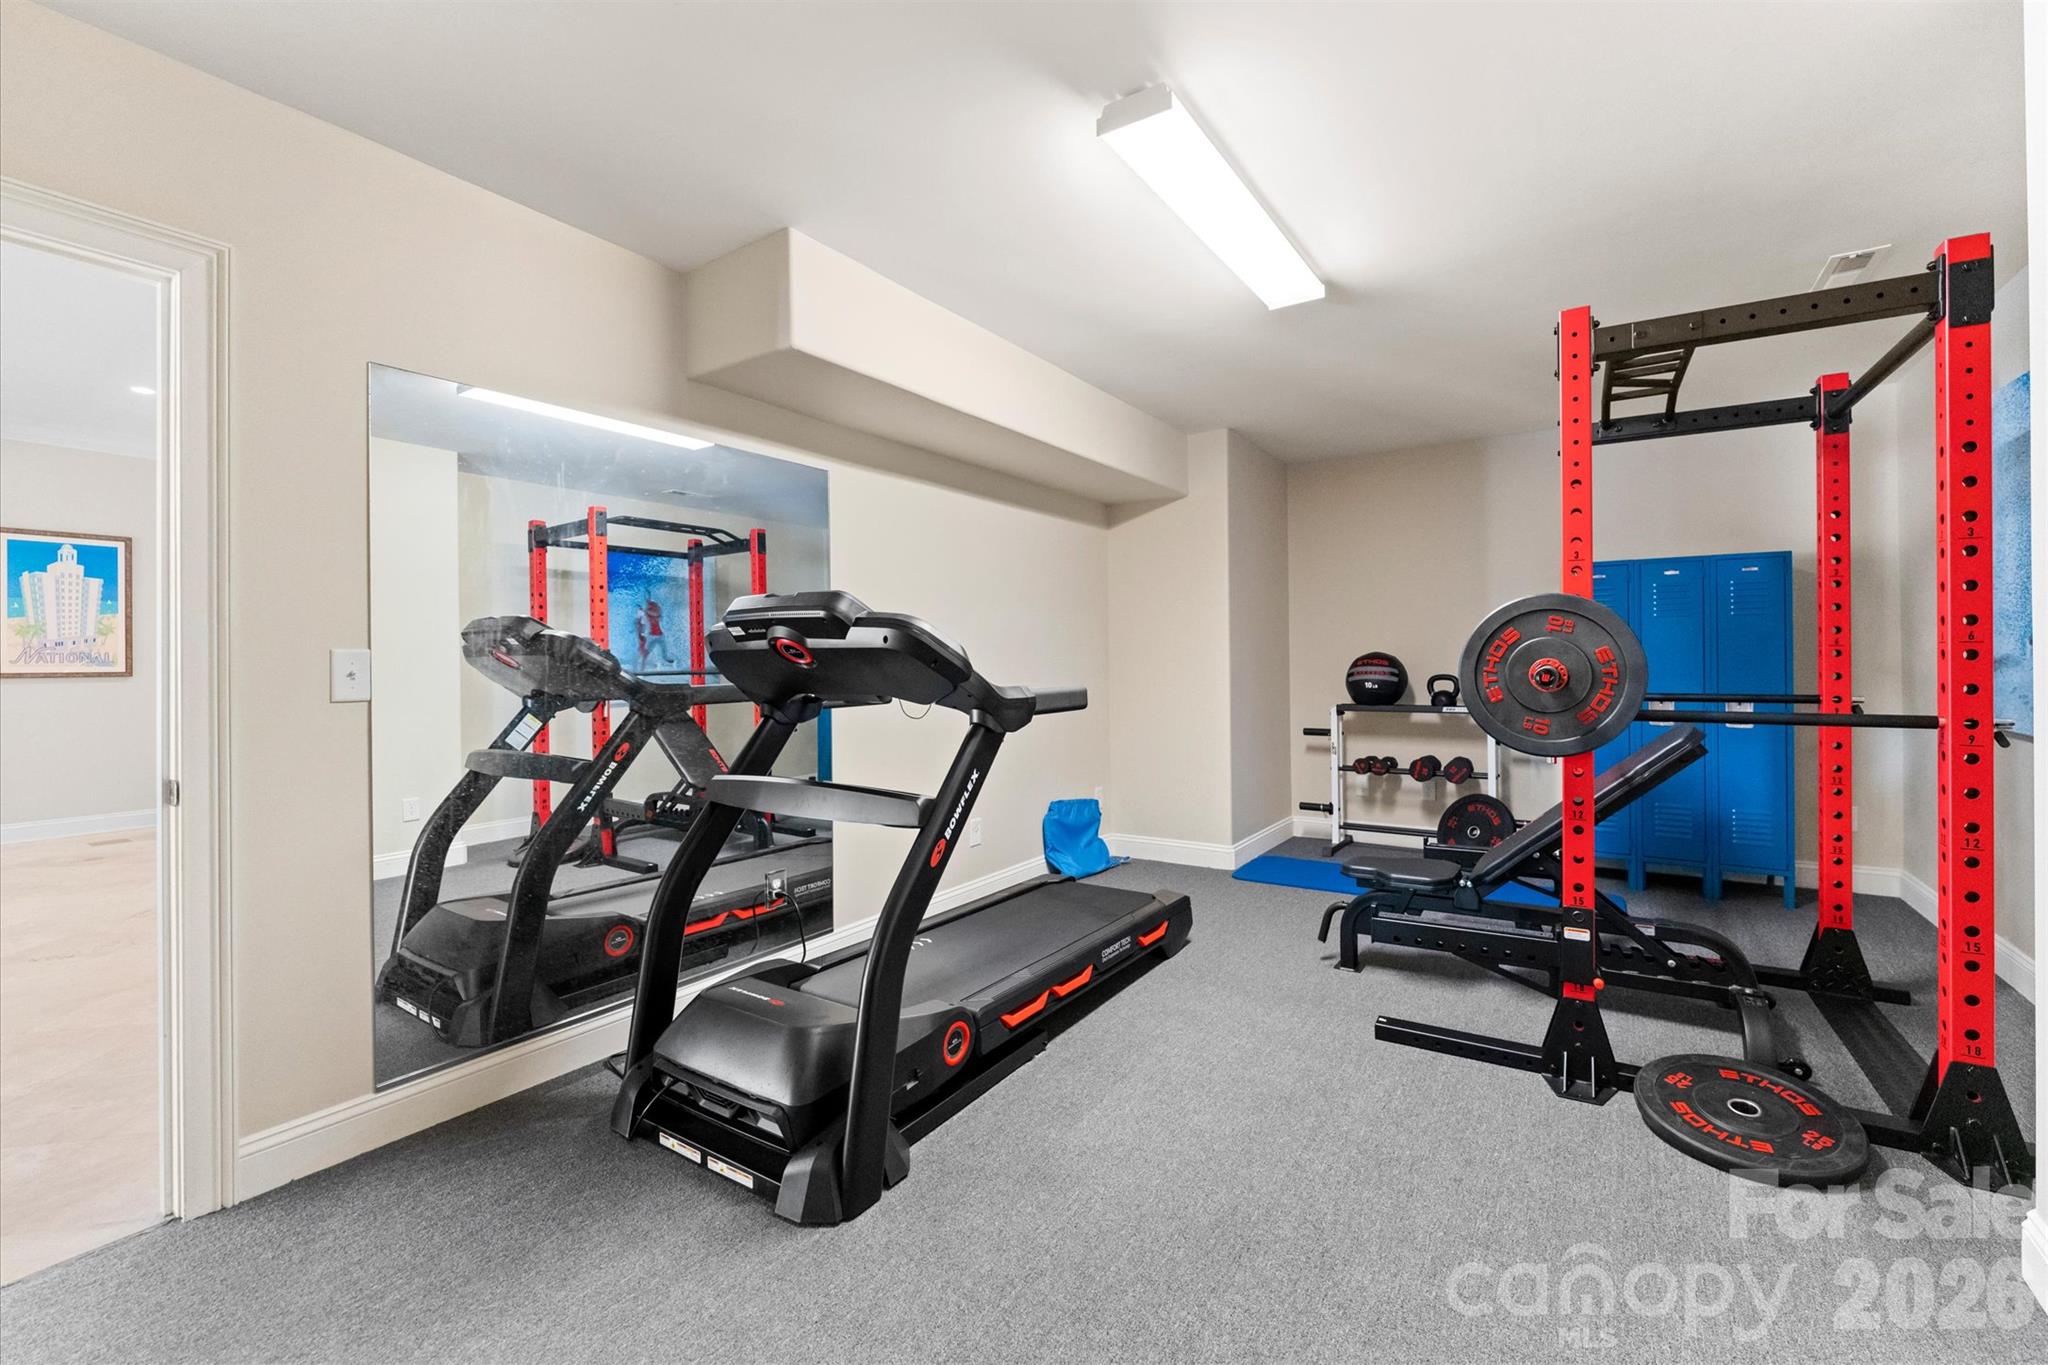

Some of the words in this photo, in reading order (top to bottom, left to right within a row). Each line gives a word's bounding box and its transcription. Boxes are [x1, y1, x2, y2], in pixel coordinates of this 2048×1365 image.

[1967, 527, 1975, 537] 3
[1573, 550, 1580, 560] 3
[1545, 615, 1565, 632] 10
[1562, 619, 1576, 634] LB
[1967, 631, 1975, 641] 6
[8, 645, 114, 665] NATIONAL
[1482, 626, 1521, 703] ETHOS
[1577, 644, 1619, 725] ETHOS
[1533, 718, 1551, 736] 10
[1968, 734, 1976, 745] 9
[944, 768, 980, 841] BOWFLEX
[1572, 810, 1584, 819] 12
[1965, 838, 1980, 848] 12
[1573, 896, 1585, 905] 15
[1101, 941, 1121, 958] COMFORT
[1965, 942, 1981, 952] 15
[1966, 1045, 1982, 1056] 18
[1718, 1068, 1824, 1117] ETHOS
[1670, 1100, 1775, 1154] ETHOS
[1802, 1130, 1836, 1148] 25
